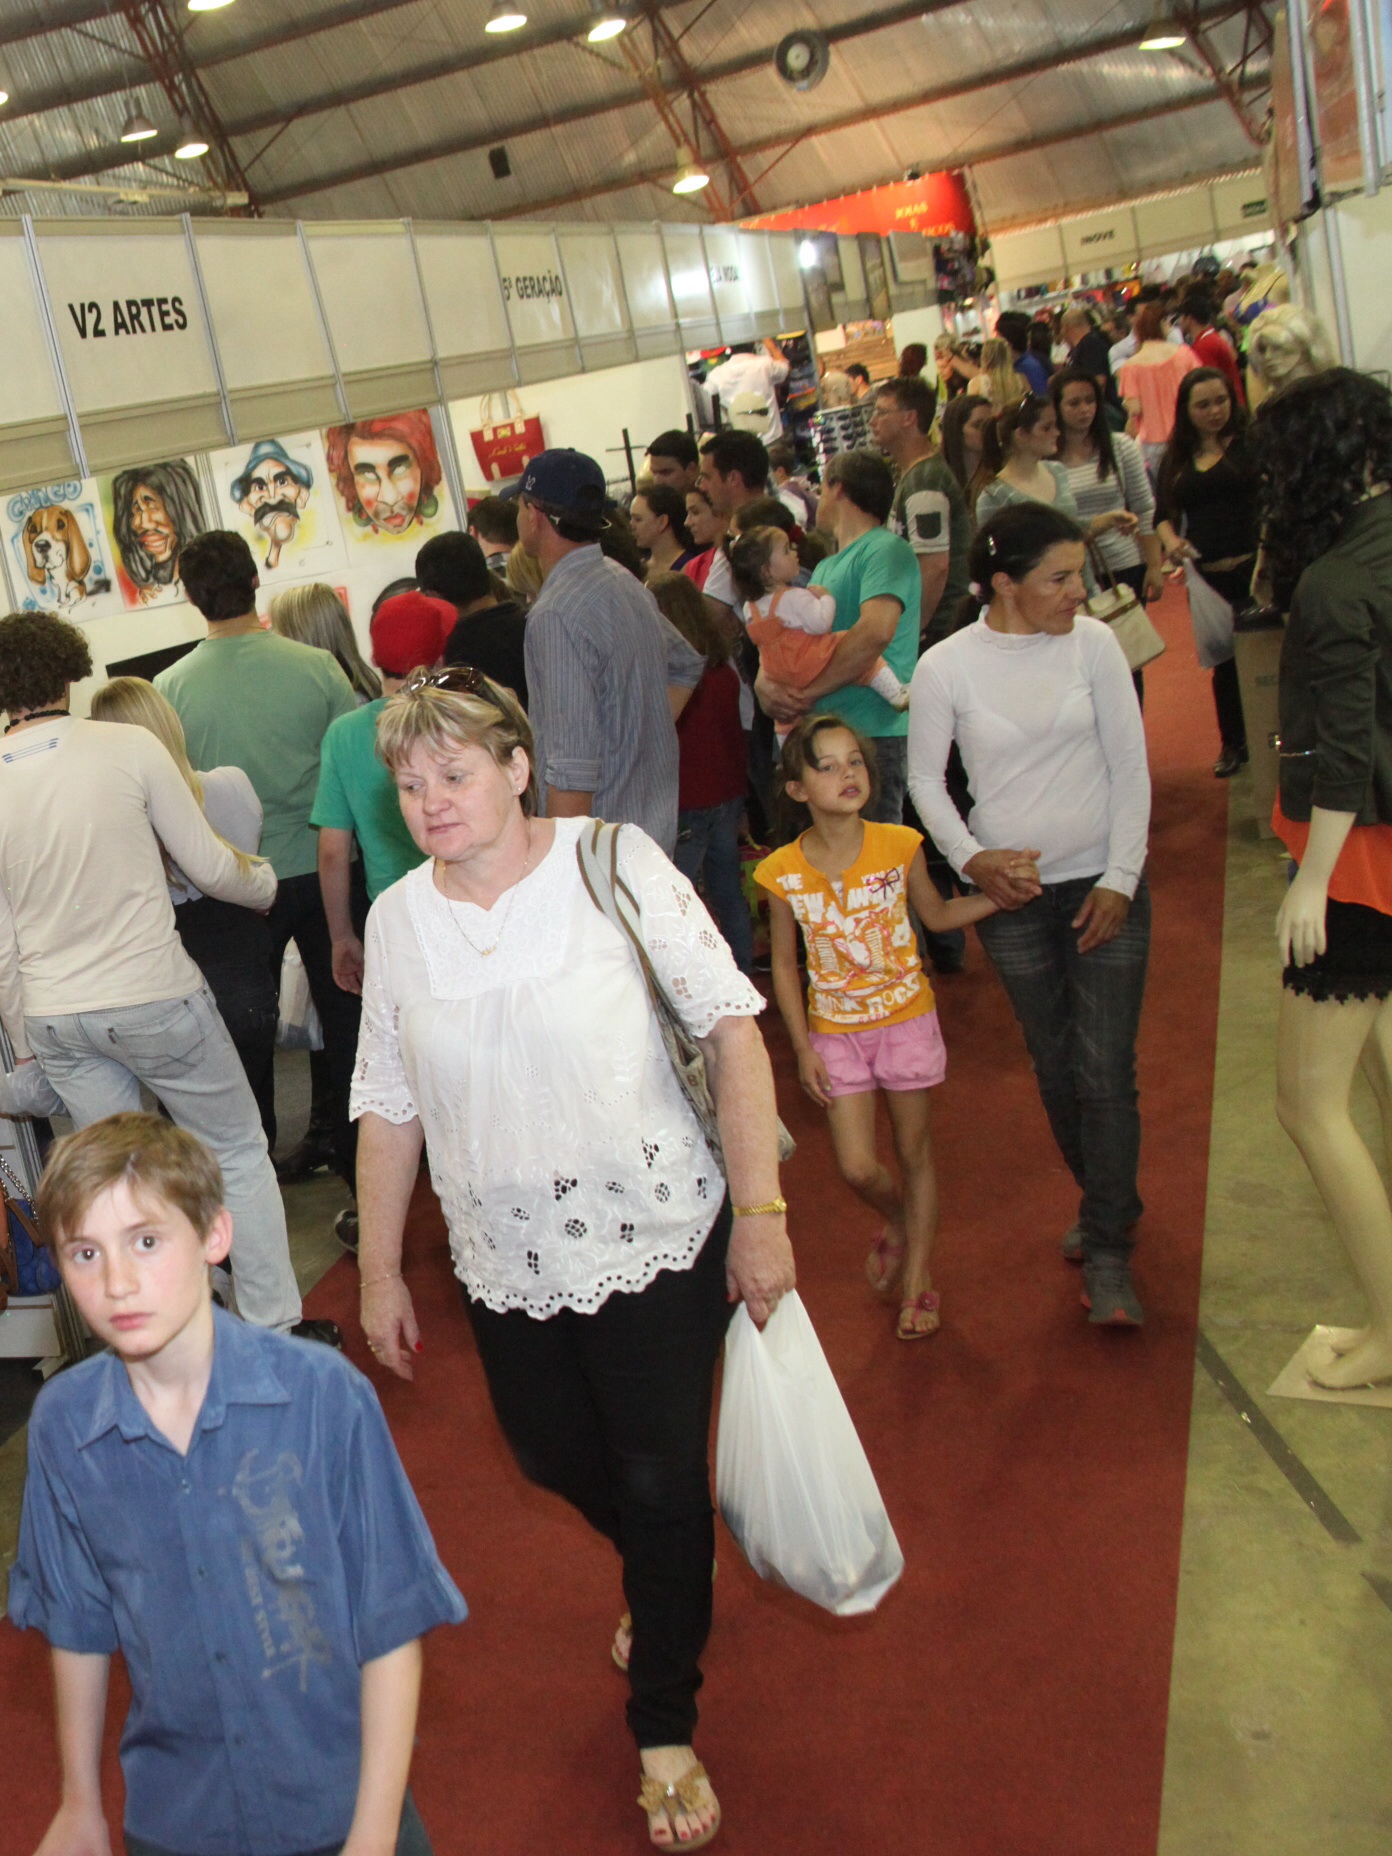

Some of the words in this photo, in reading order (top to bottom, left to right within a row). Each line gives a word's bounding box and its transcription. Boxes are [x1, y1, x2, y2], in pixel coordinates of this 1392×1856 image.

[515, 269, 564, 304] GERAÇÃO
[67, 300, 107, 339] V2
[112, 296, 188, 336] ARTES
